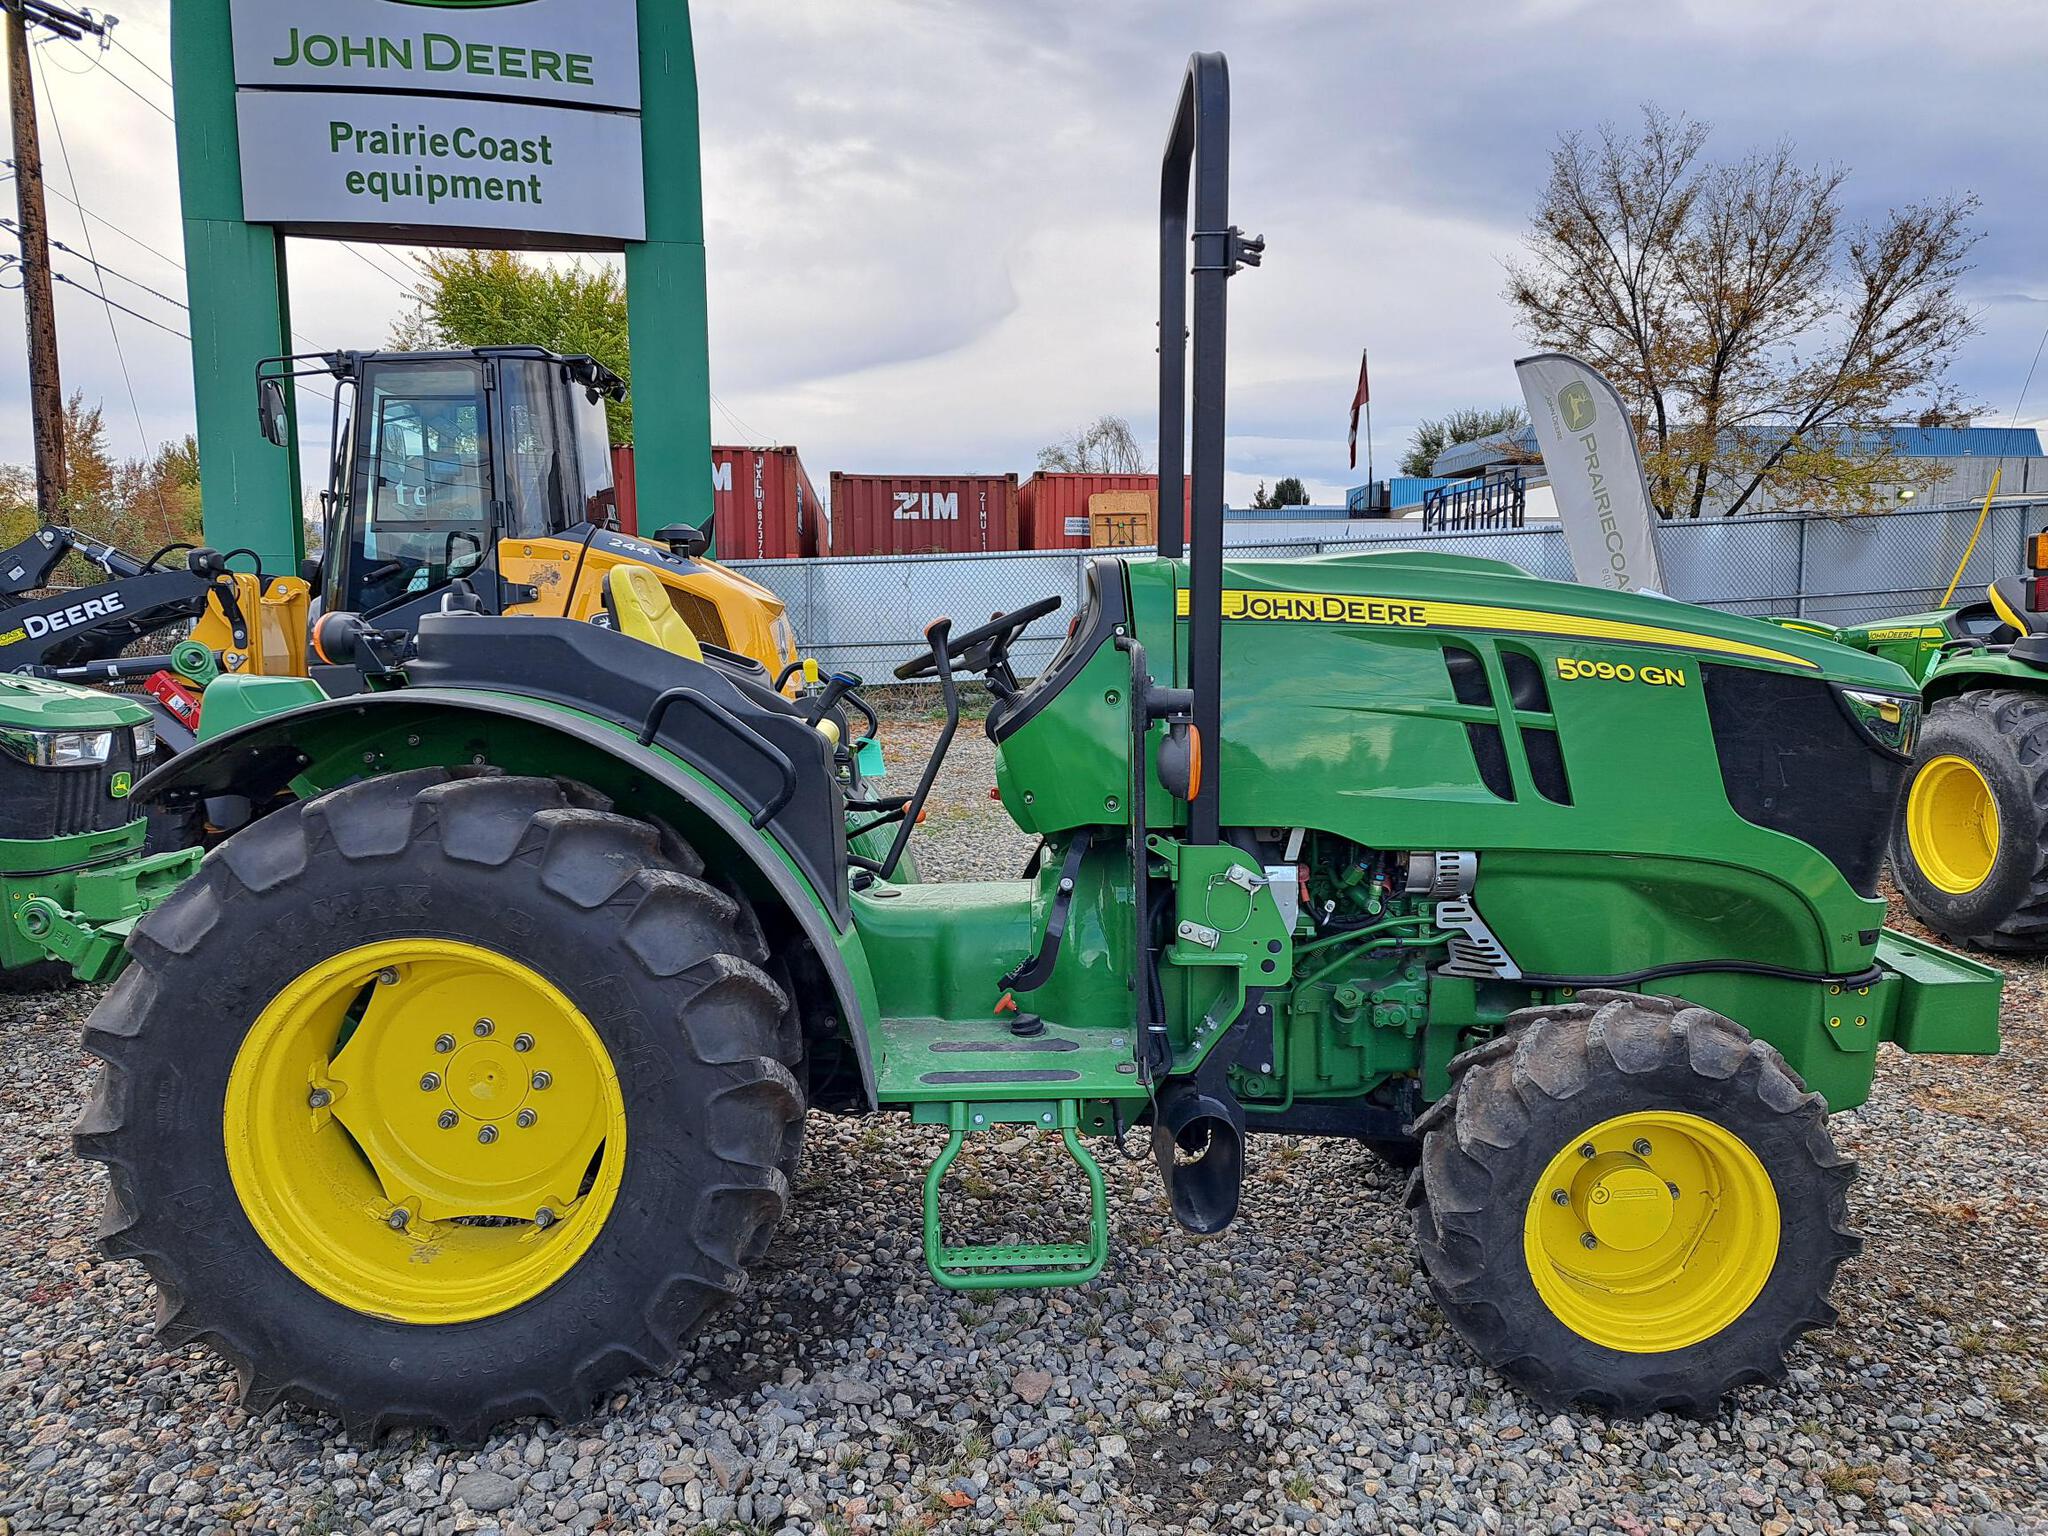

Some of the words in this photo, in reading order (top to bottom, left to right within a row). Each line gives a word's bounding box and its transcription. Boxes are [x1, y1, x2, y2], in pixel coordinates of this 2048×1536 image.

[274, 27, 413, 70] JOHN
[423, 33, 594, 86] DEERE
[329, 121, 553, 166] PrairieCoast
[345, 165, 543, 205] equipment
[893, 491, 959, 520] ZIM
[608, 538, 651, 555] 244
[23, 591, 125, 640] DEERE
[1231, 593, 1316, 618] JOHN
[1322, 597, 1427, 624] DEERE
[1887, 630, 1914, 639] DEERE
[1556, 657, 1636, 682] 5090
[1639, 666, 1686, 687] GN
